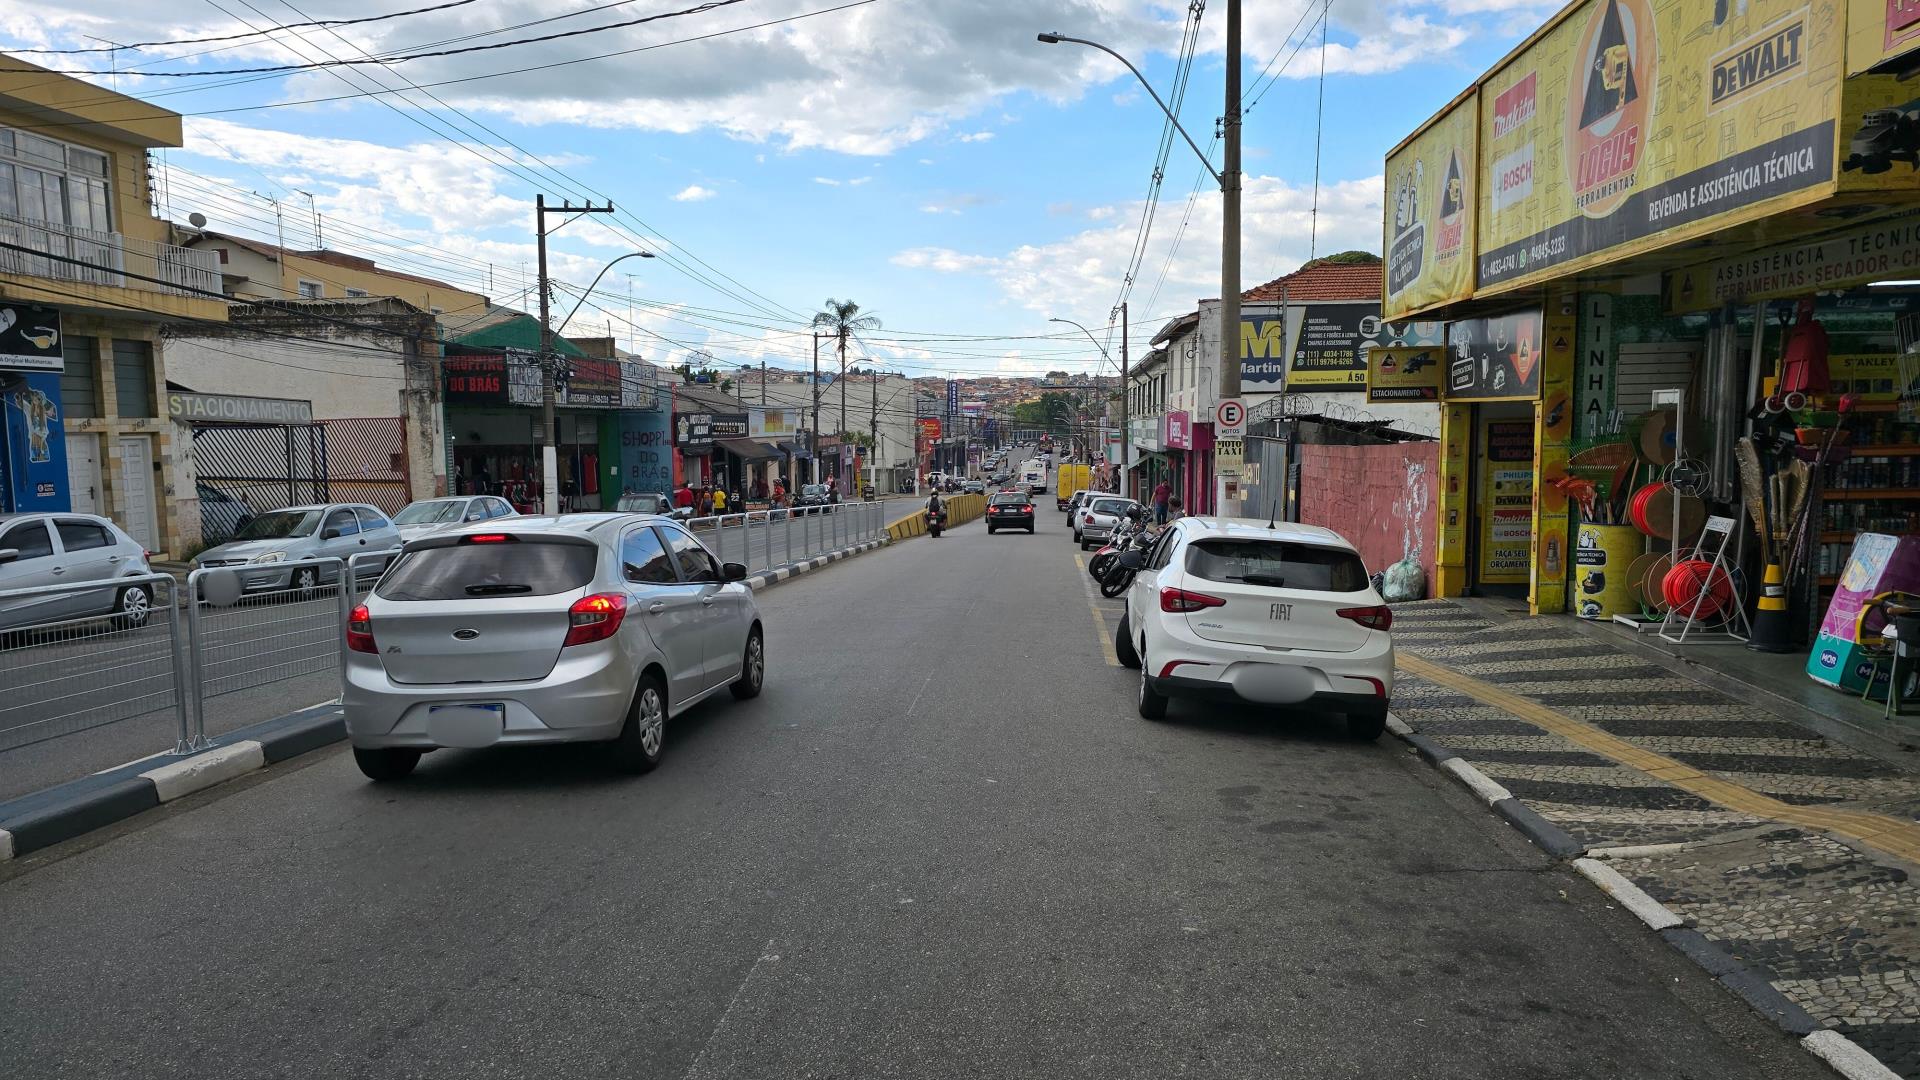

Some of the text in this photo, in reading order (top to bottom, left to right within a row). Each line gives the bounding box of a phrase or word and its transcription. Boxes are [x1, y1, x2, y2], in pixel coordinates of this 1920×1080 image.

[1576, 125, 1639, 193] LOGUS
[1503, 160, 1532, 192] BOSCH
[1649, 146, 1815, 222] REVENDA E ASSISTÊNCIA TÉCNICA
[1576, 174, 1635, 209] FERRAMENTAS
[1717, 247, 1824, 281] ASSISTÊNCIA
[1716, 271, 1804, 299] FERRAMENTAS
[1815, 254, 1888, 283] SECADOR
[1587, 302, 1605, 414] LINHA
[1844, 358, 1895, 367] STANLEY
[469, 373, 500, 392] BRÁS
[1355, 373, 1364, 382] 50
[1372, 389, 1421, 397] ESTACIONAMENTO
[168, 395, 310, 421] STACIONAMENTO
[1226, 407, 1235, 421] E
[1217, 440, 1241, 448] MOTO
[1495, 550, 1527, 559] FAÇA SEU
[1269, 603, 1293, 621] FIAT
[1821, 652, 1836, 665] MOR
